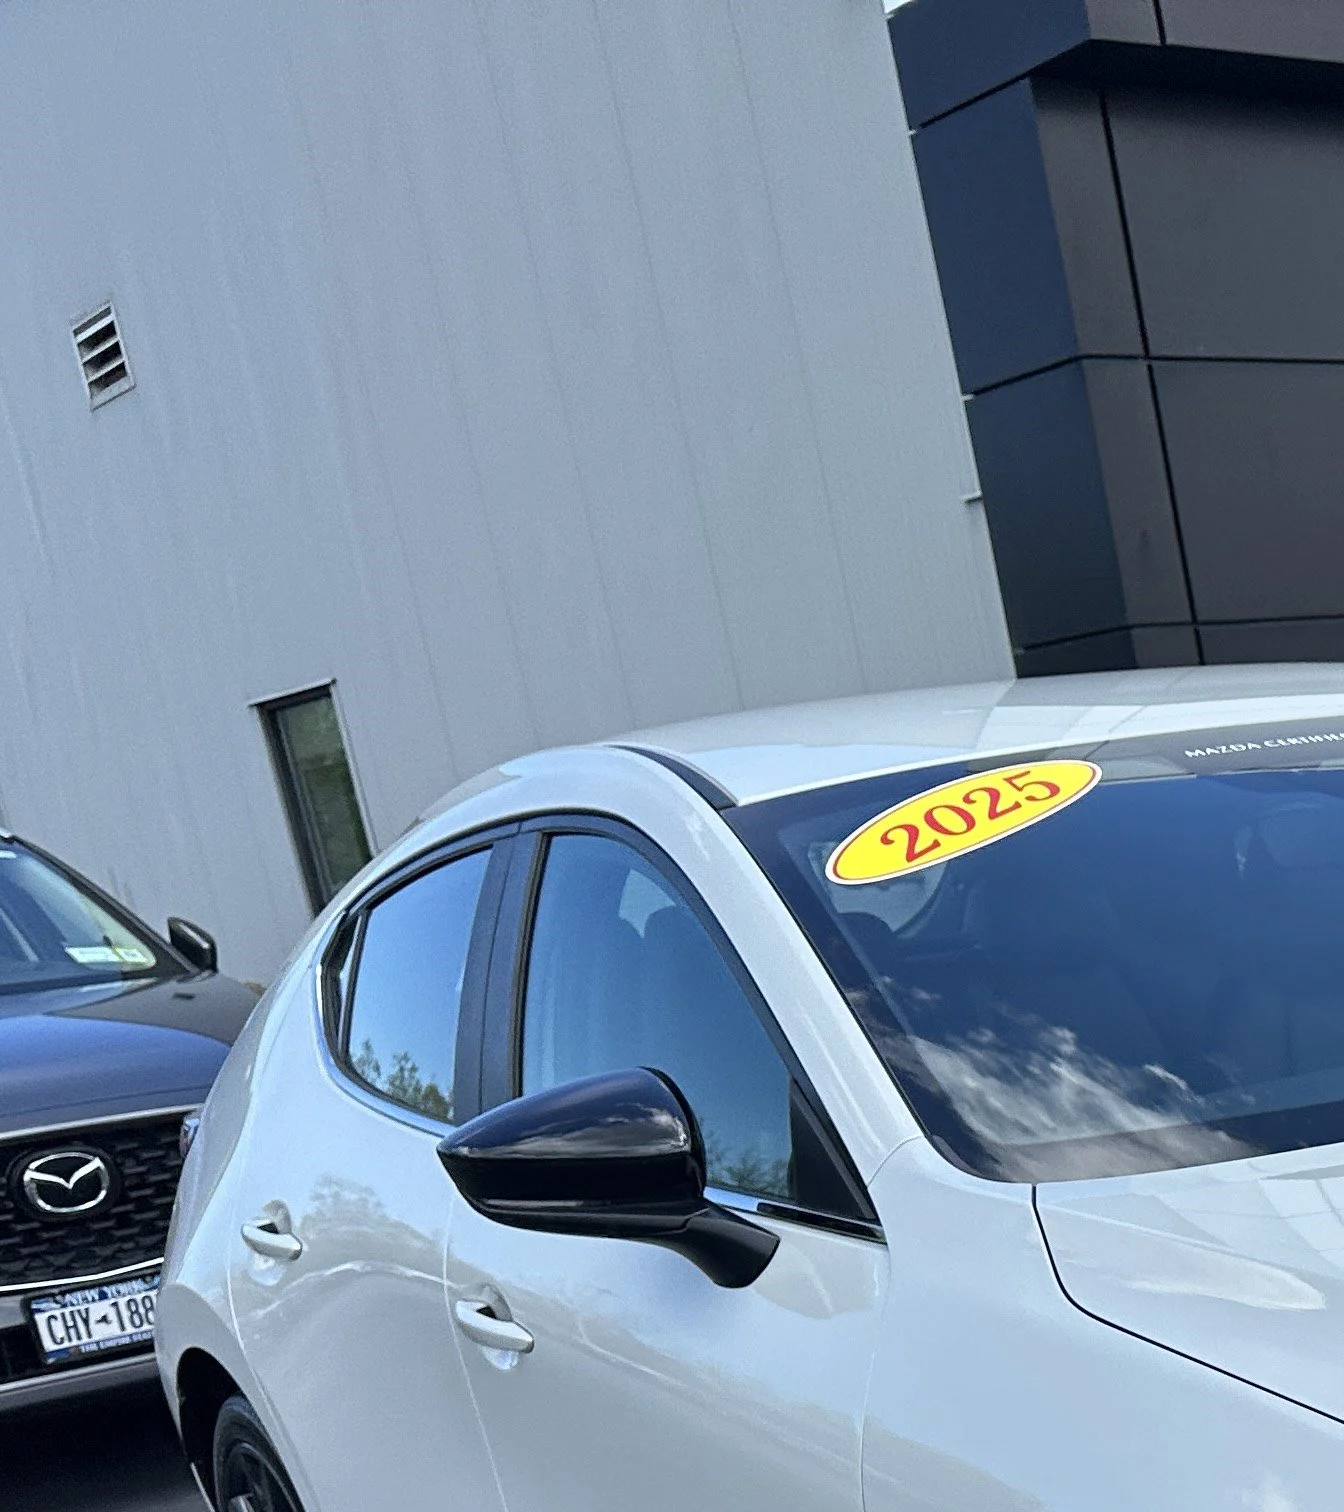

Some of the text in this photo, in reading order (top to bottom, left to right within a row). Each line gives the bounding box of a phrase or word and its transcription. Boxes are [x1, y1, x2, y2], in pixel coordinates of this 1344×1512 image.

[1185, 741, 1262, 758] MAZDA
[880, 770, 1061, 863] 2025
[47, 1307, 93, 1345] CHY
